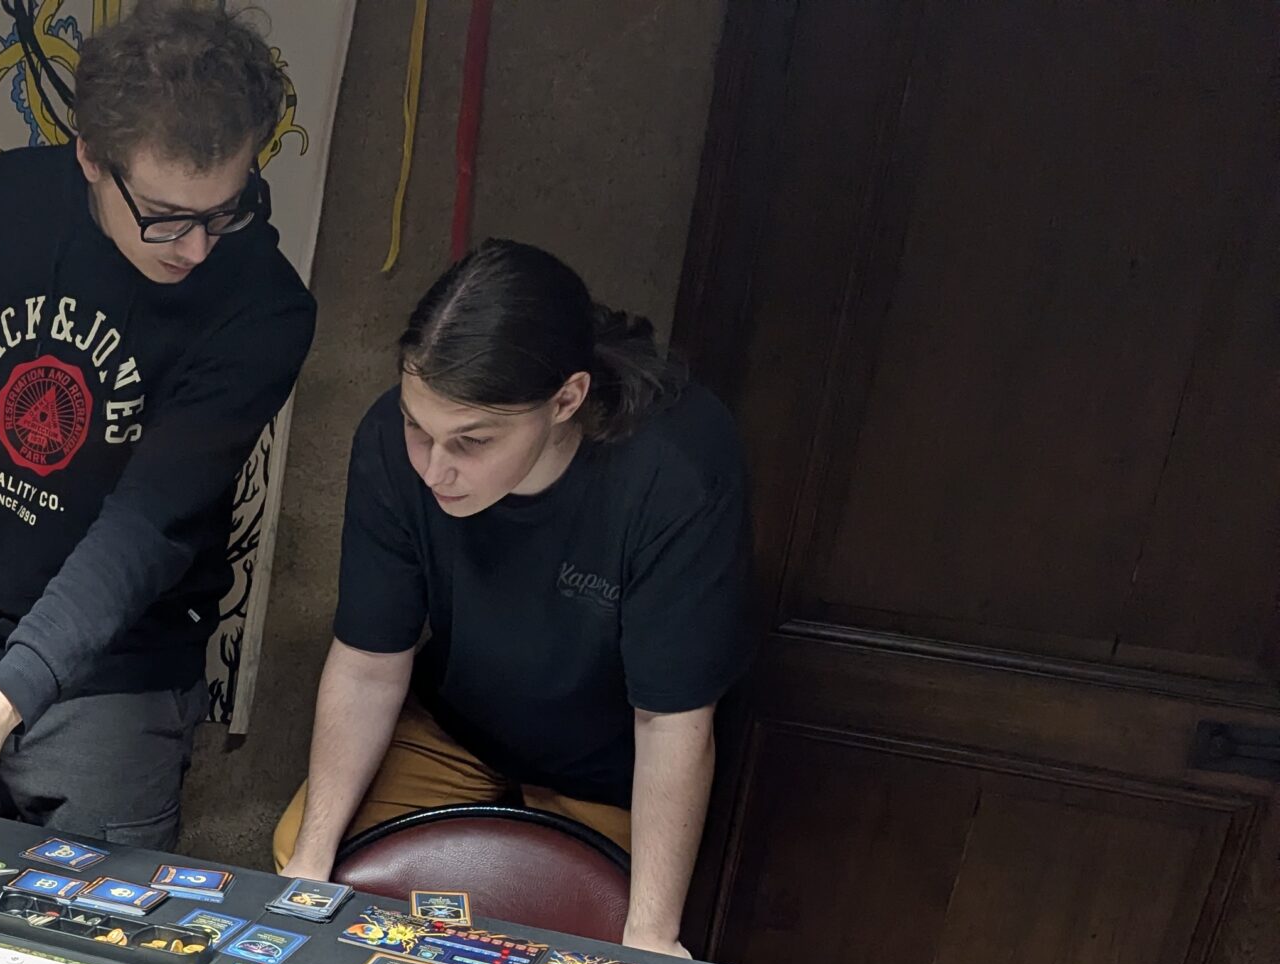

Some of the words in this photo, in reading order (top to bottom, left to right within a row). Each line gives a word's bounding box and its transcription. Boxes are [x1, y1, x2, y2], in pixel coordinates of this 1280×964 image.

[5, 368, 46, 431] RESERVATION
[47, 368, 72, 386] AND
[19, 445, 48, 465] PARK
[39, 491, 65, 512] CO.
